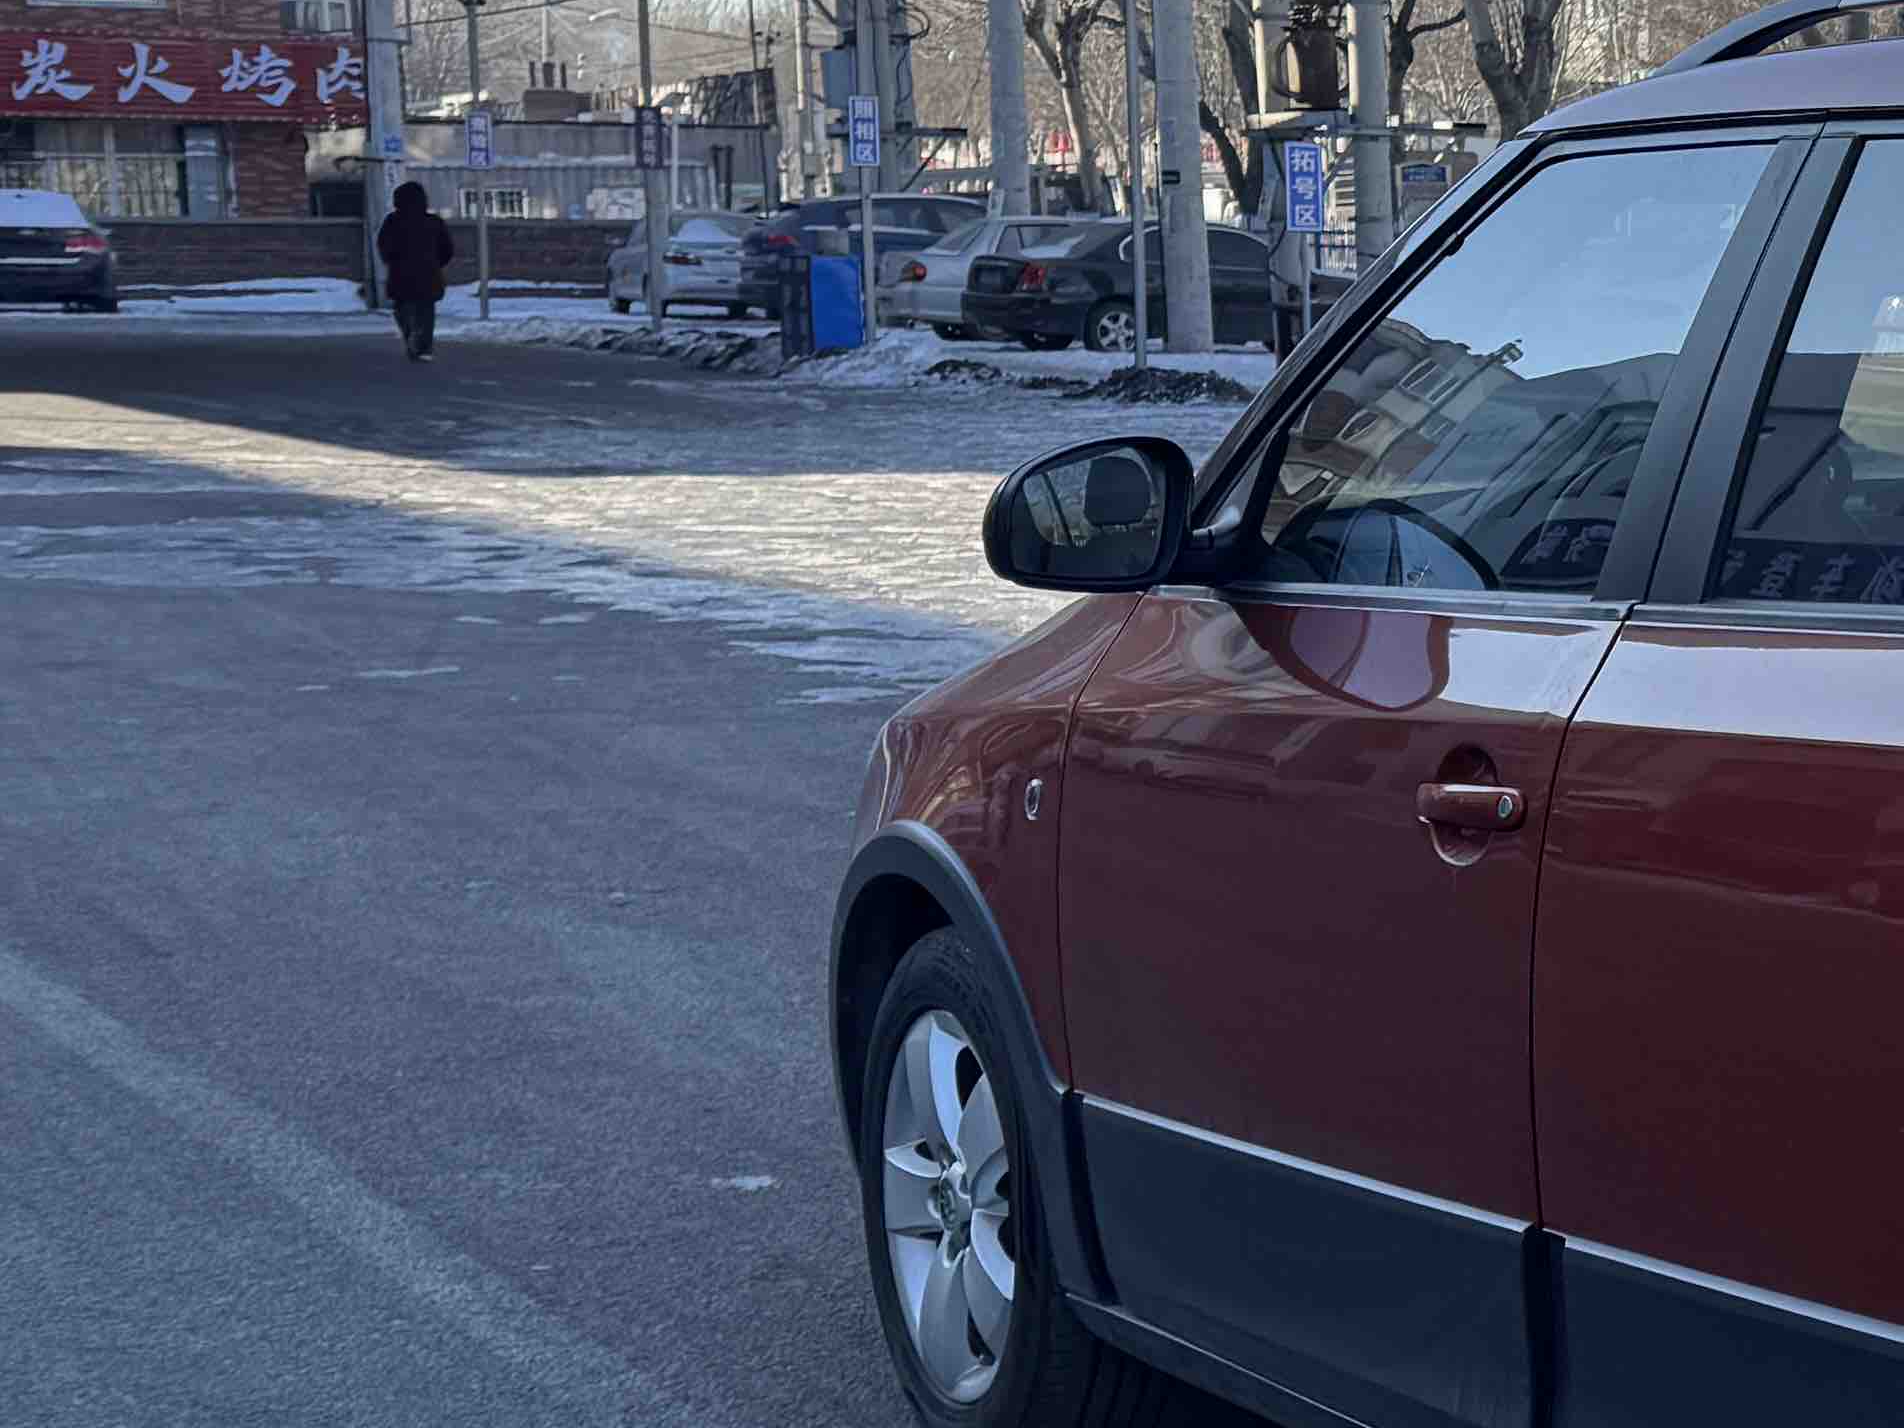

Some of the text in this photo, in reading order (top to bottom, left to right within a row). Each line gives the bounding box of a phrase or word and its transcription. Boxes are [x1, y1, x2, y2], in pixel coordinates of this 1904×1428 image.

[11, 39, 366, 108] 炭火烤肉
[1292, 148, 1316, 226] 拓号区
